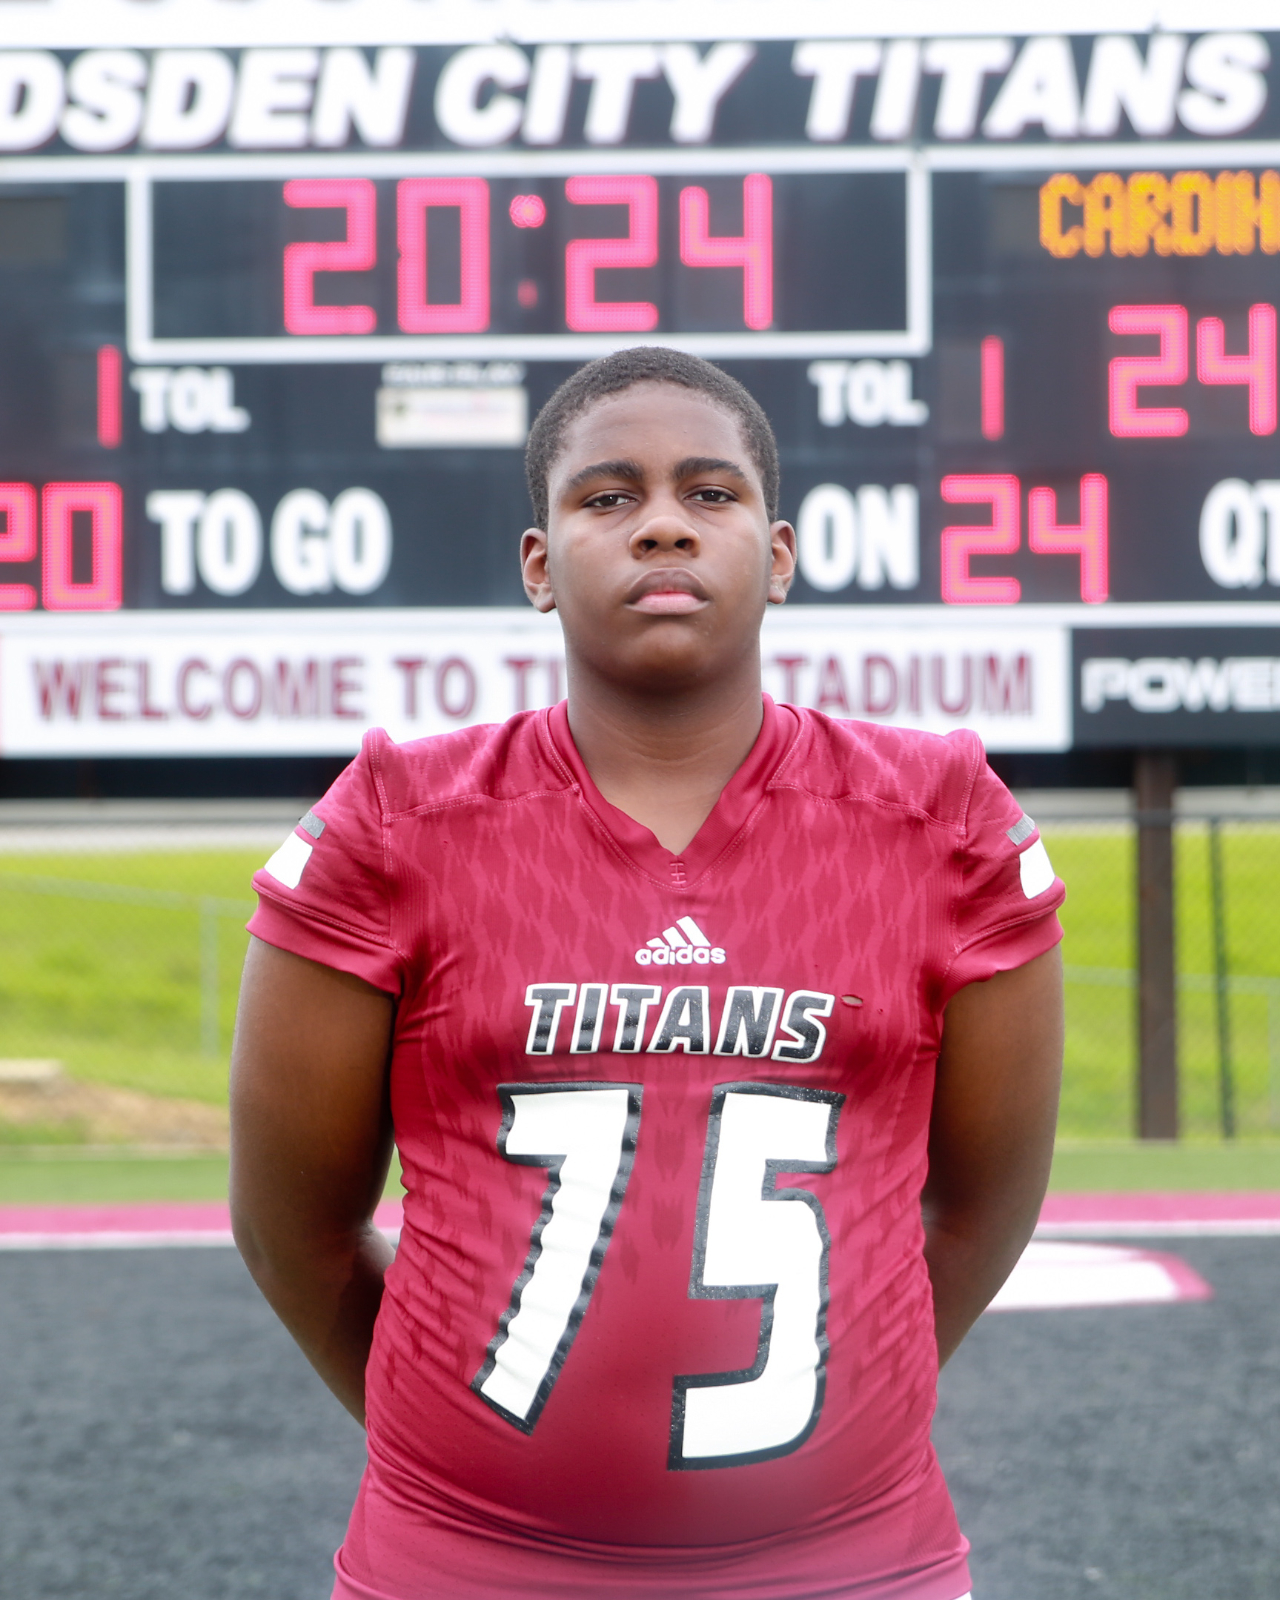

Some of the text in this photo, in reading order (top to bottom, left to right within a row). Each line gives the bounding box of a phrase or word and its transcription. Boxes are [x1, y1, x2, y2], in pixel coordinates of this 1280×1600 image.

[434, 44, 757, 147] CITY
[792, 34, 1270, 141] TITANS
[283, 173, 773, 335] 20:24
[1108, 303, 1277, 437] 24
[146, 487, 392, 596] TO GO
[797, 483, 921, 592] ON
[940, 473, 1108, 605] 24
[32, 656, 366, 723] WELCOME
[393, 656, 480, 721] TO
[772, 651, 1035, 718] TADIUM
[635, 944, 727, 966] adidas
[523, 982, 836, 1064] TITANS
[470, 1080, 847, 1472] 75
